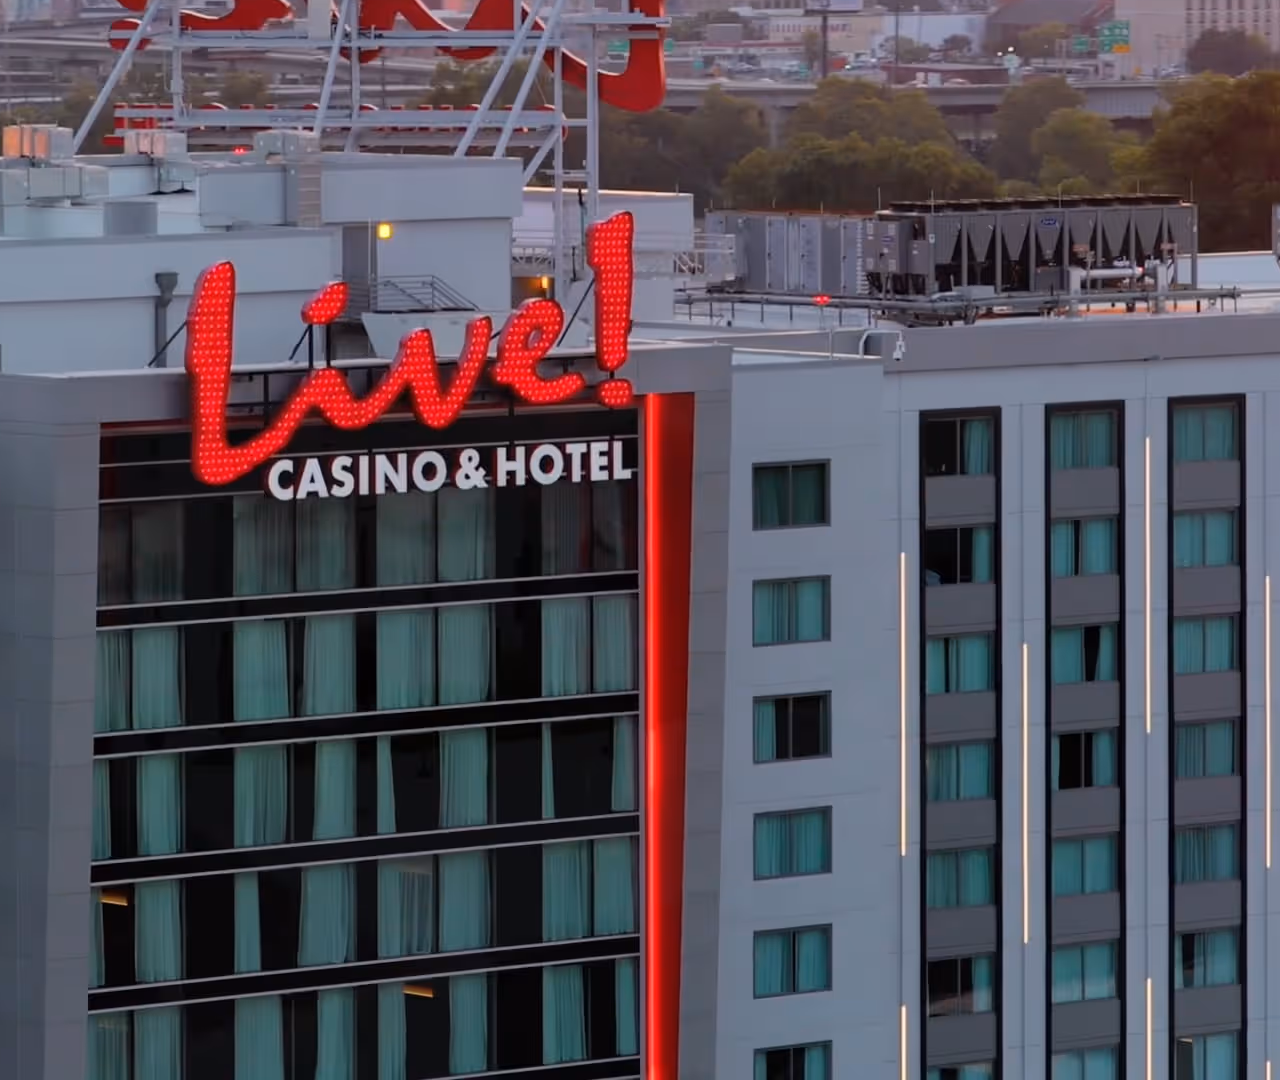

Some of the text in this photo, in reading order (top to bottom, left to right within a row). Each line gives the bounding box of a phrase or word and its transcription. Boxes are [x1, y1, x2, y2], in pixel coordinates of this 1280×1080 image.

[185, 211, 634, 485] Live!
[268, 441, 632, 500] CASINO & HOTEL
